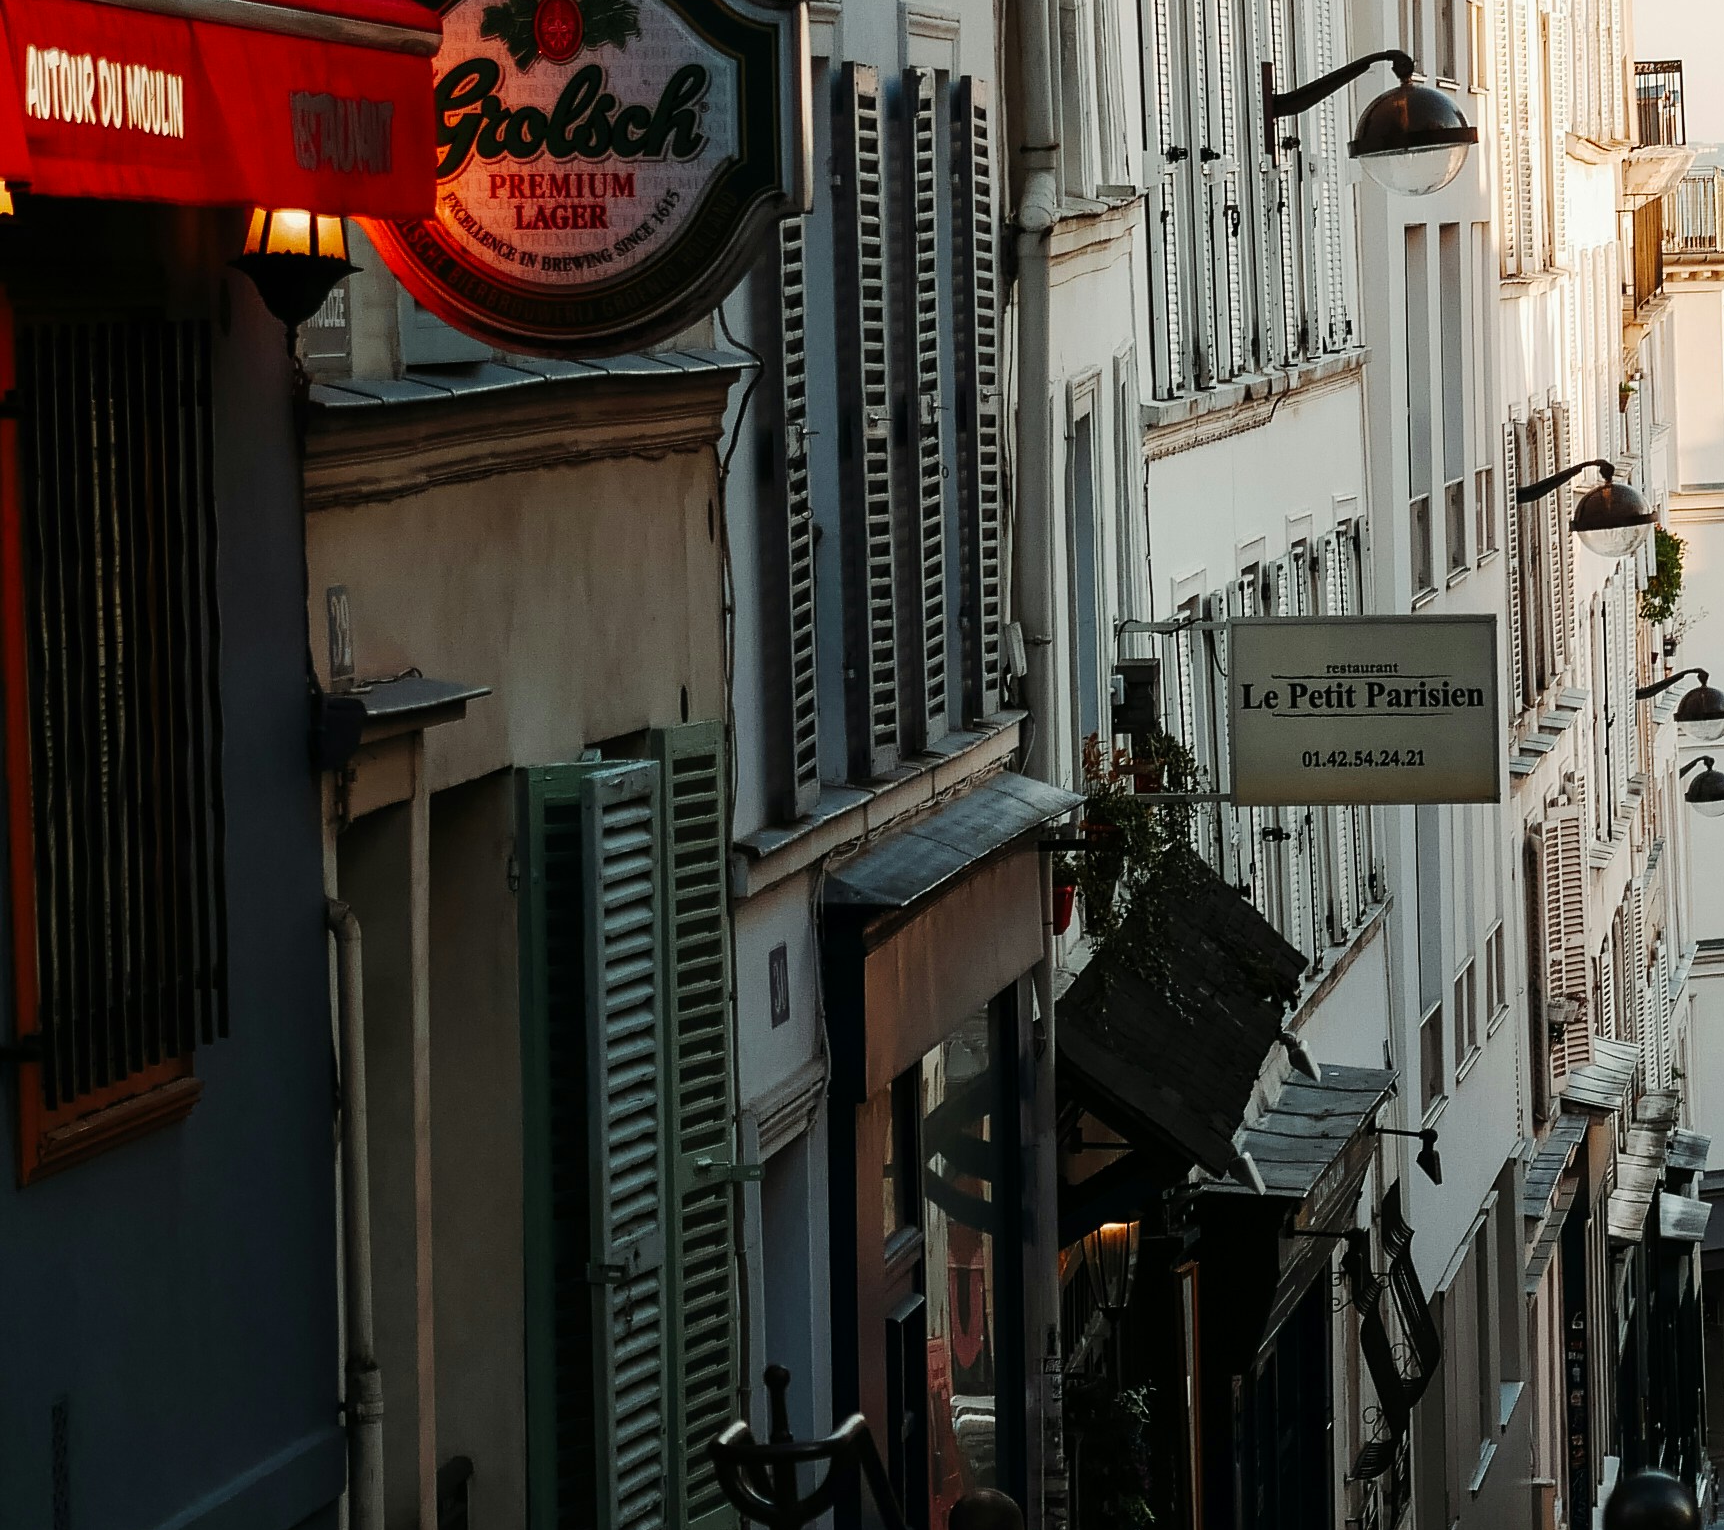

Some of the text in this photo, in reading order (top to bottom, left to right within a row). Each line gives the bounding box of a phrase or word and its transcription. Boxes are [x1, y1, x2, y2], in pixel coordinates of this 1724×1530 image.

[25, 43, 184, 140] AUTOUR DU MOULIN
[435, 63, 706, 180] Grolsch
[489, 172, 636, 200] PREMIUM
[441, 189, 681, 273] EXCELLENCE IN BREWING SINCE 1615
[513, 204, 609, 230] LAGER
[1325, 661, 1399, 675] restaurant
[1240, 680, 1484, 710] Le Petit Parisien
[1301, 749, 1425, 768] 01.42.54.24.21
